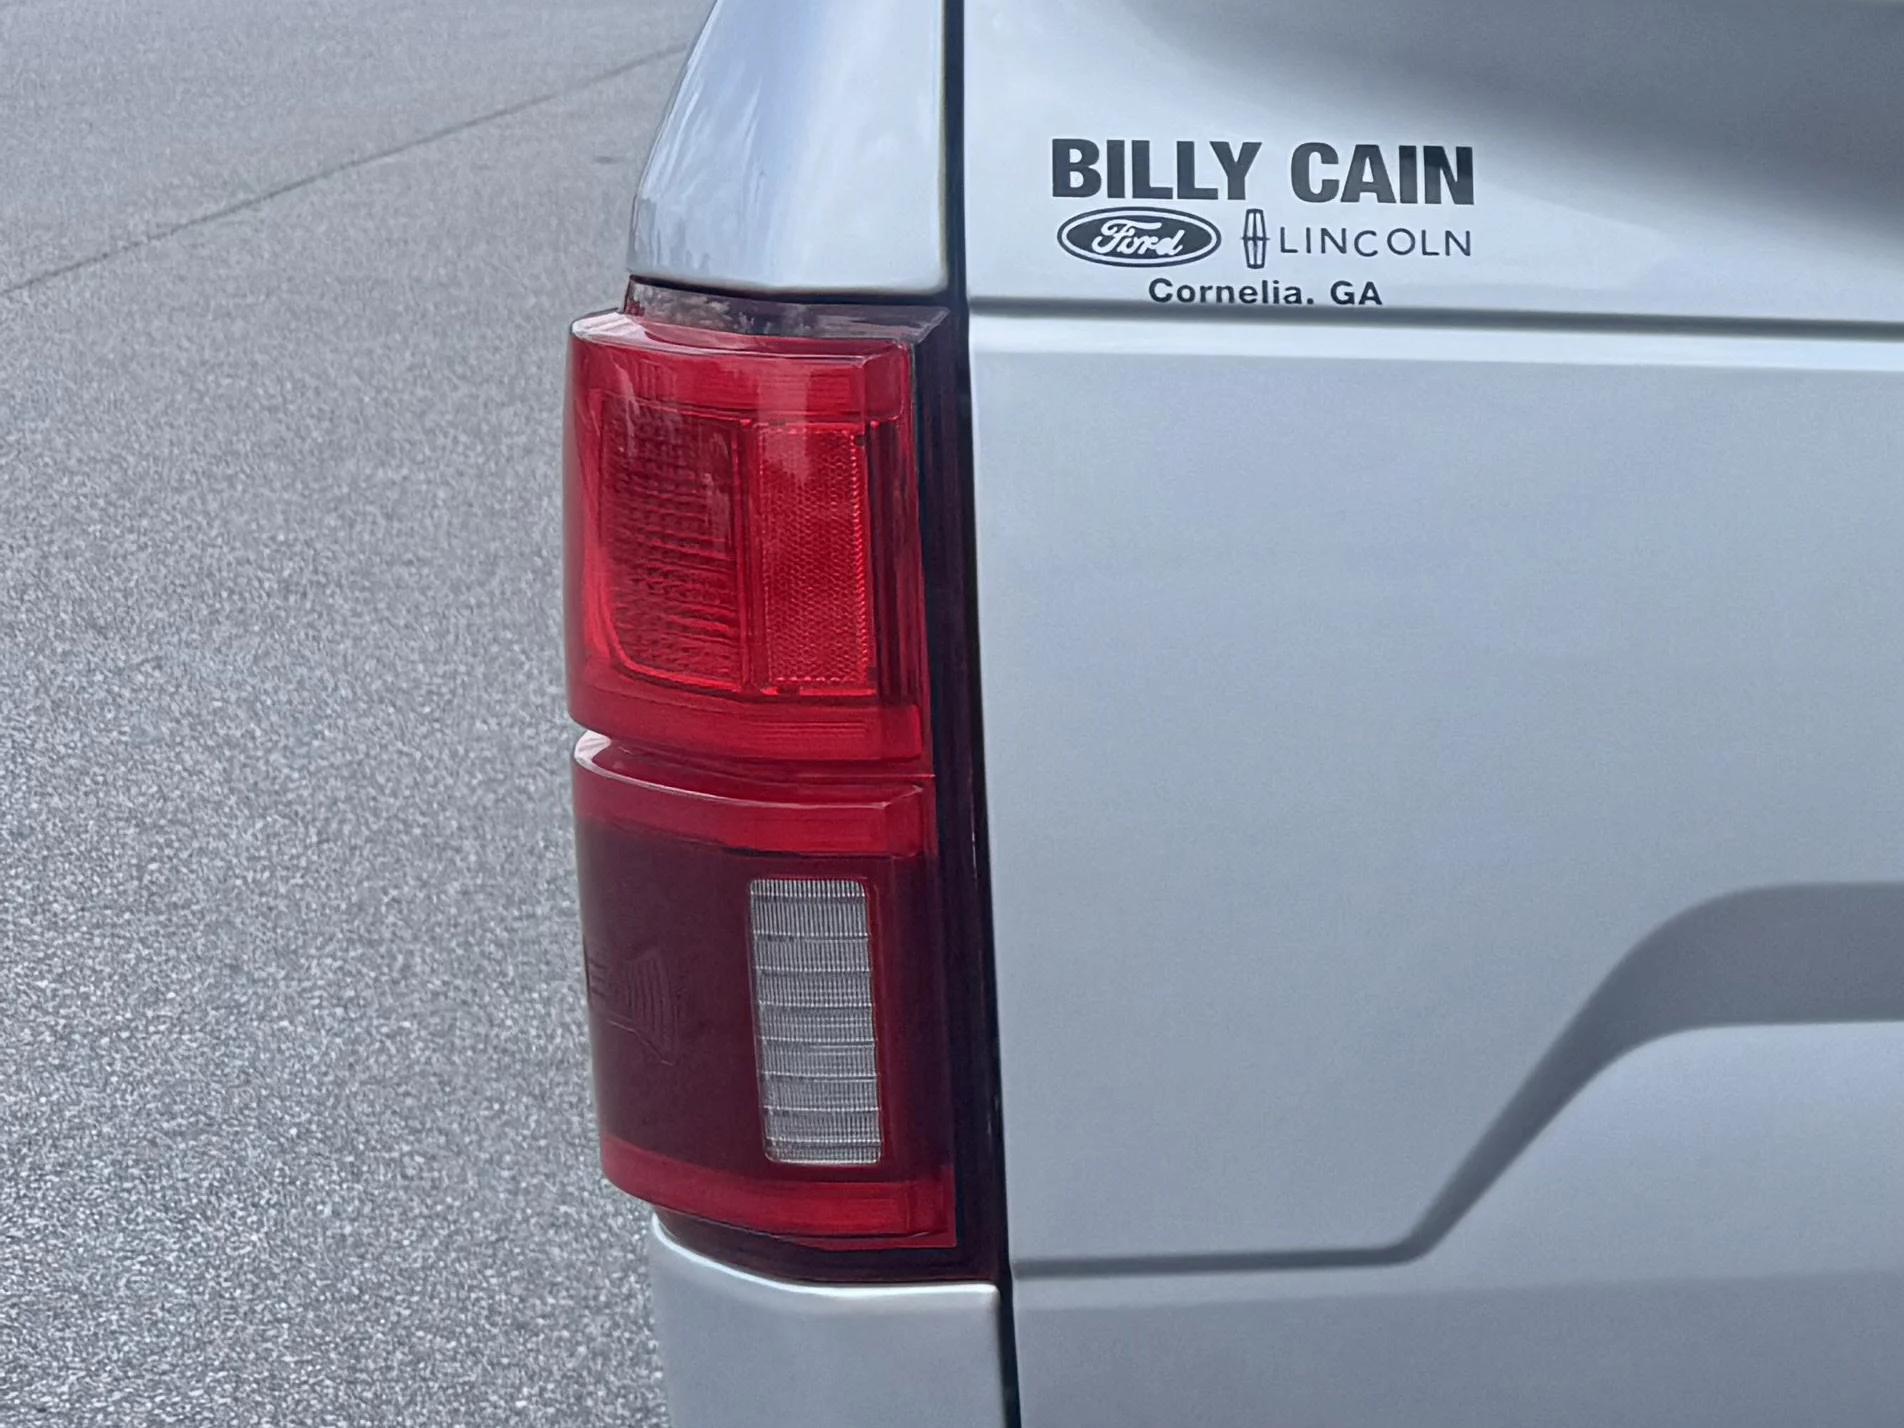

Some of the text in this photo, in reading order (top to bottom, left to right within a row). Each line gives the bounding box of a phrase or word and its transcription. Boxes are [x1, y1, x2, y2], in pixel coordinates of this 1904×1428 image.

[1051, 138, 1475, 205] BILLY CAIN
[1092, 218, 1472, 258] Ford LINCOLN
[1330, 280, 1383, 307] GA
